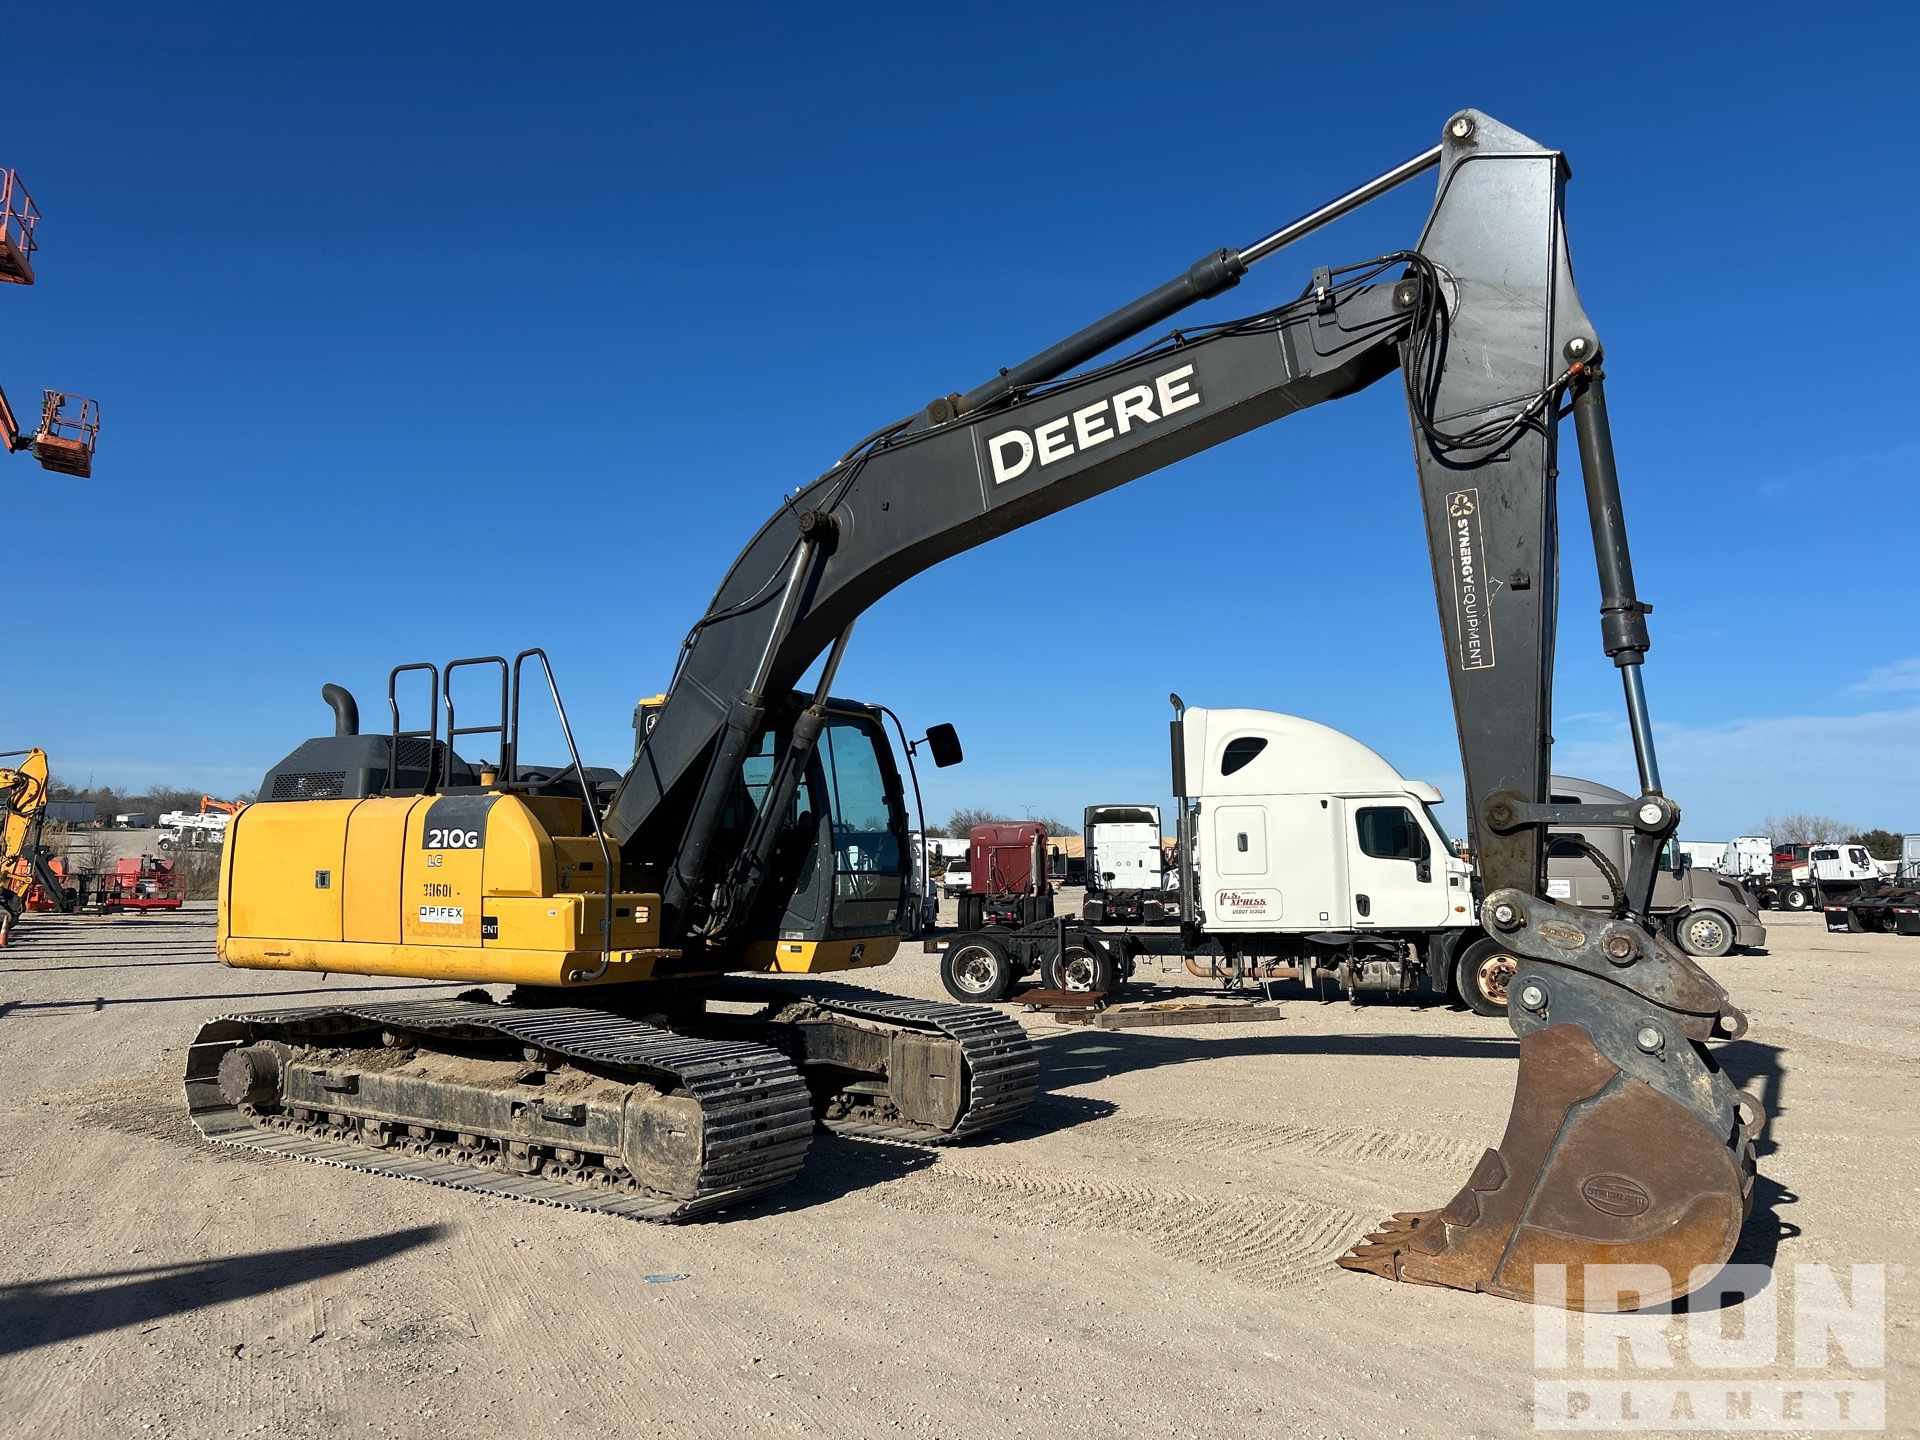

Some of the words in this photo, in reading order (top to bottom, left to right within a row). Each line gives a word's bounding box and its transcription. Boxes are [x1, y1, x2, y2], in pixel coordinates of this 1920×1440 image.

[988, 363, 1201, 485] DEERE
[428, 828, 478, 849] 210G
[427, 854, 443, 867] LC
[419, 906, 463, 918] OPIFEX
[482, 925, 498, 934] ENT
